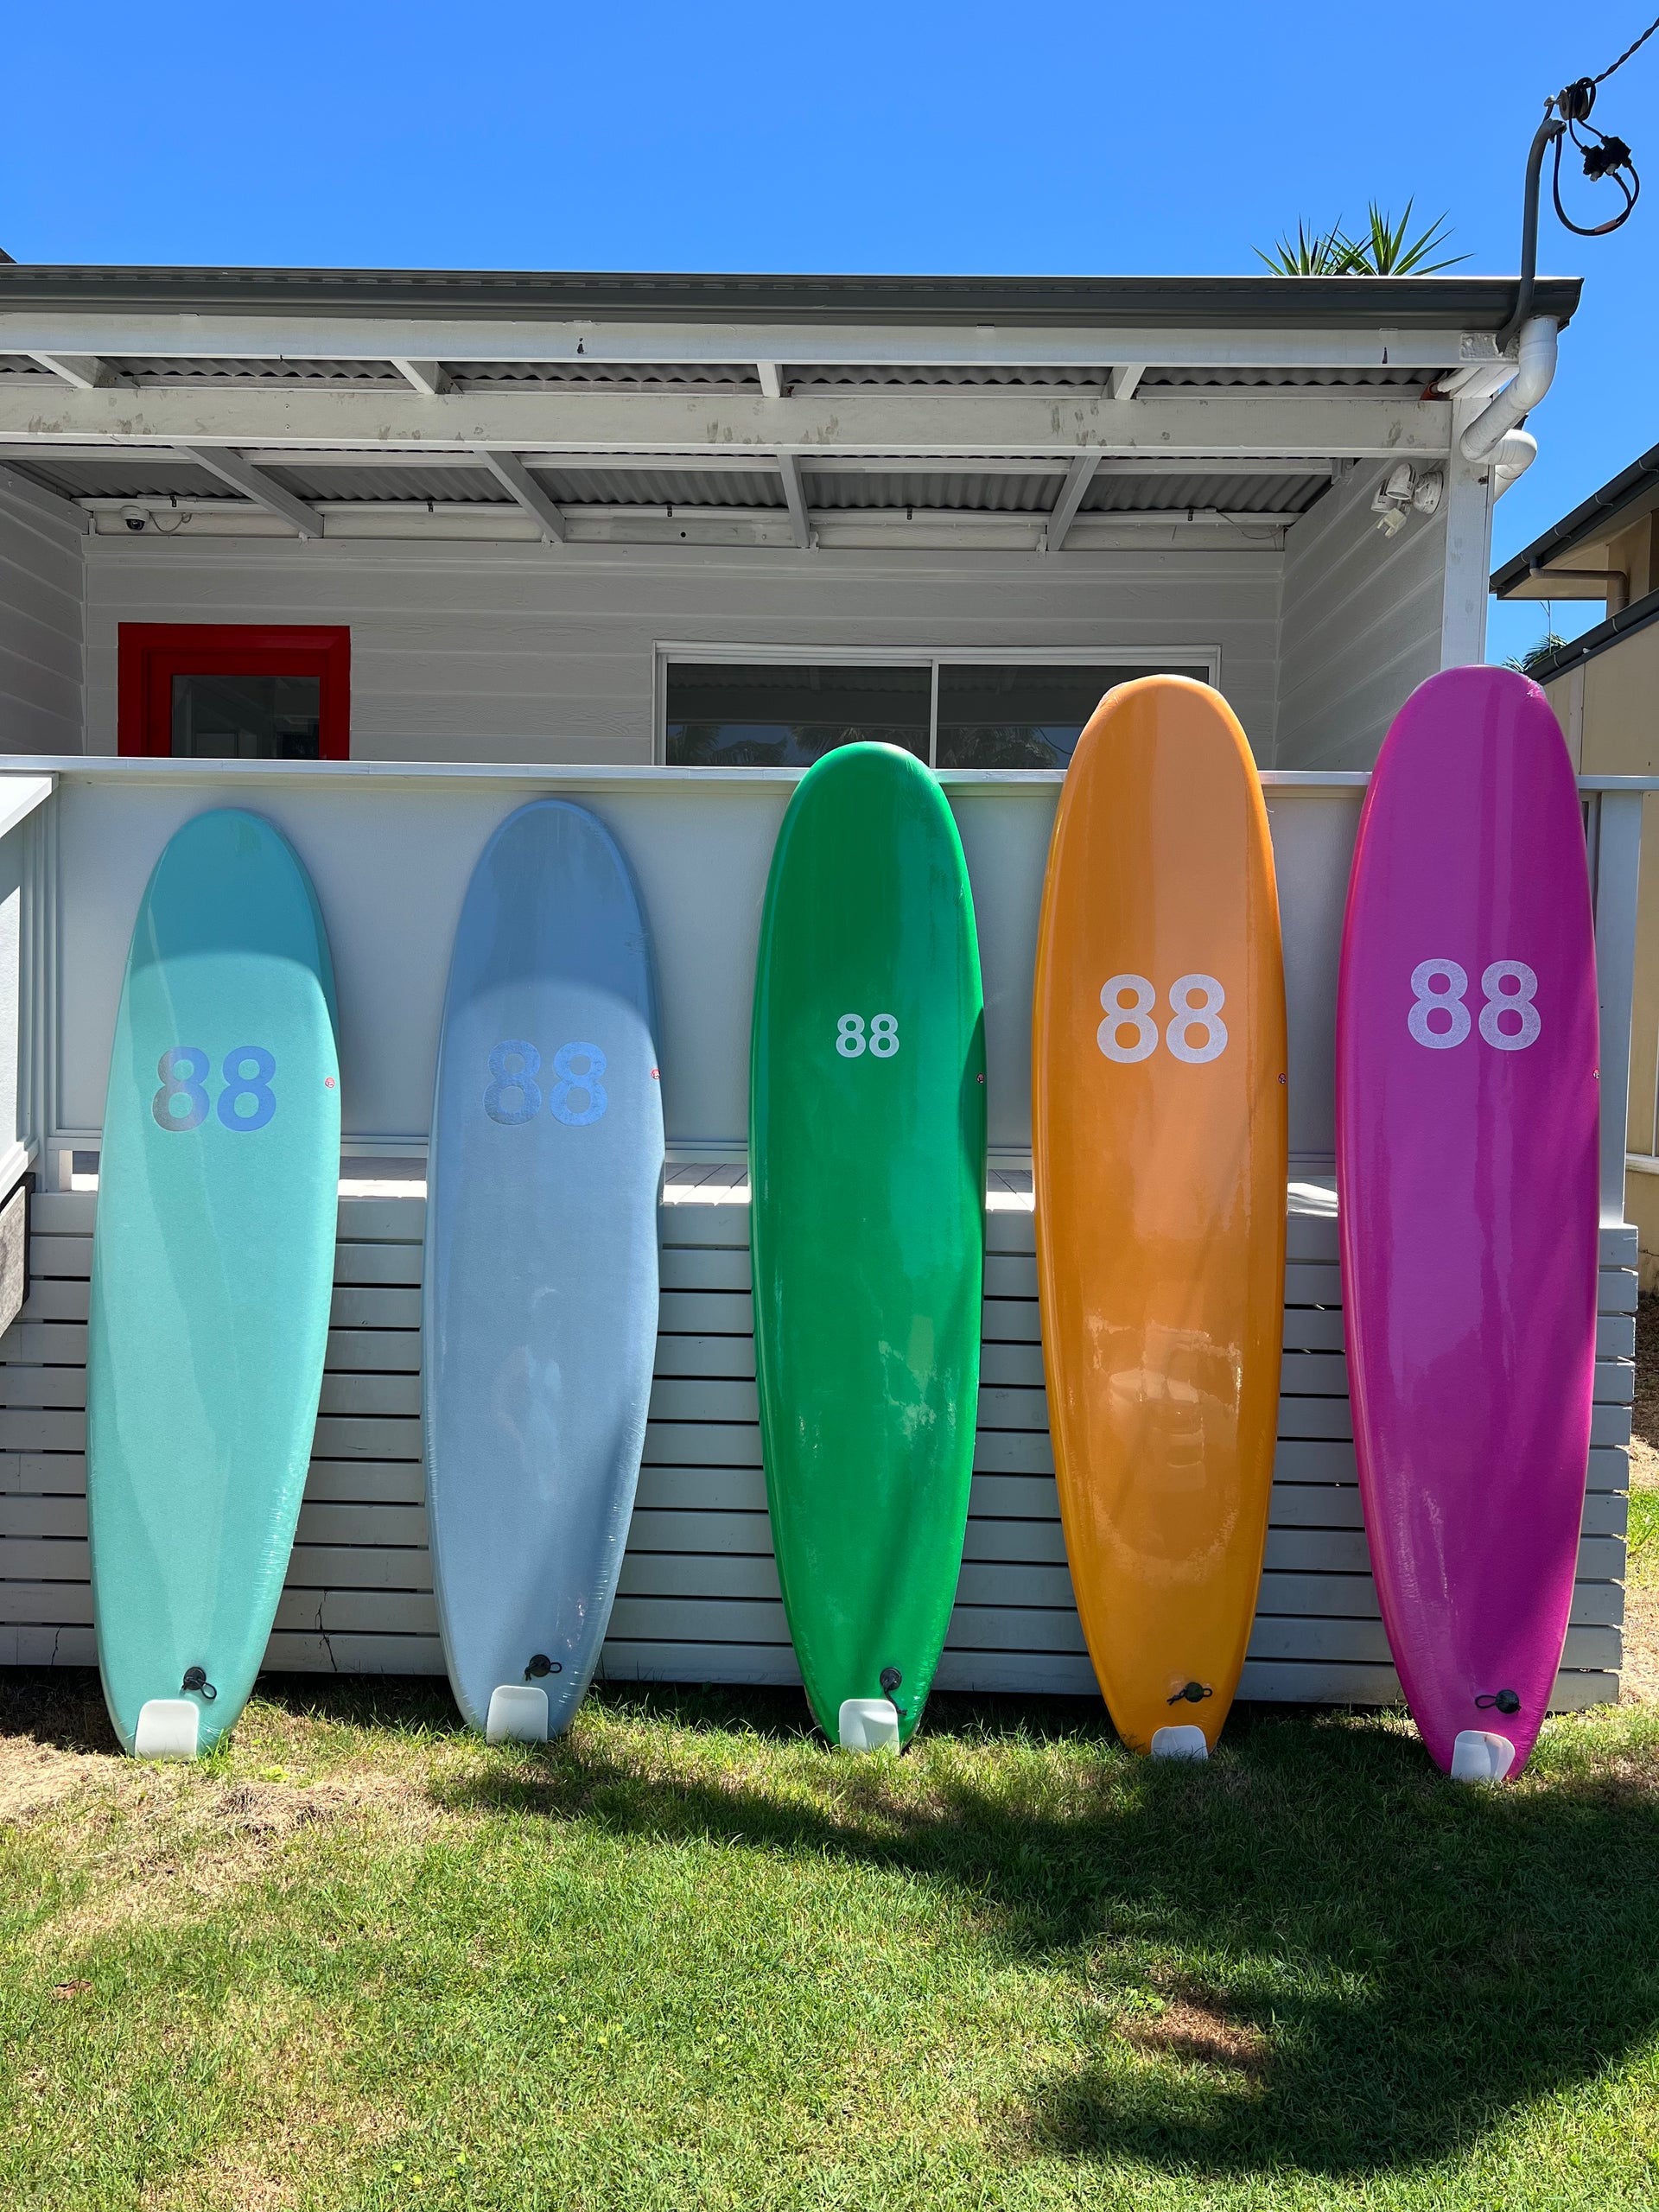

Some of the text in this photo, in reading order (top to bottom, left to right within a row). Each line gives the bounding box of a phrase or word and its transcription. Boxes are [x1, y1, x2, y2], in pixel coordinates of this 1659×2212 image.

[836, 1014, 899, 1058] 88
[1096, 974, 1228, 1063] 88
[1408, 958, 1541, 1050] 88
[152, 1046, 276, 1132] 88
[483, 1039, 607, 1126] 88
